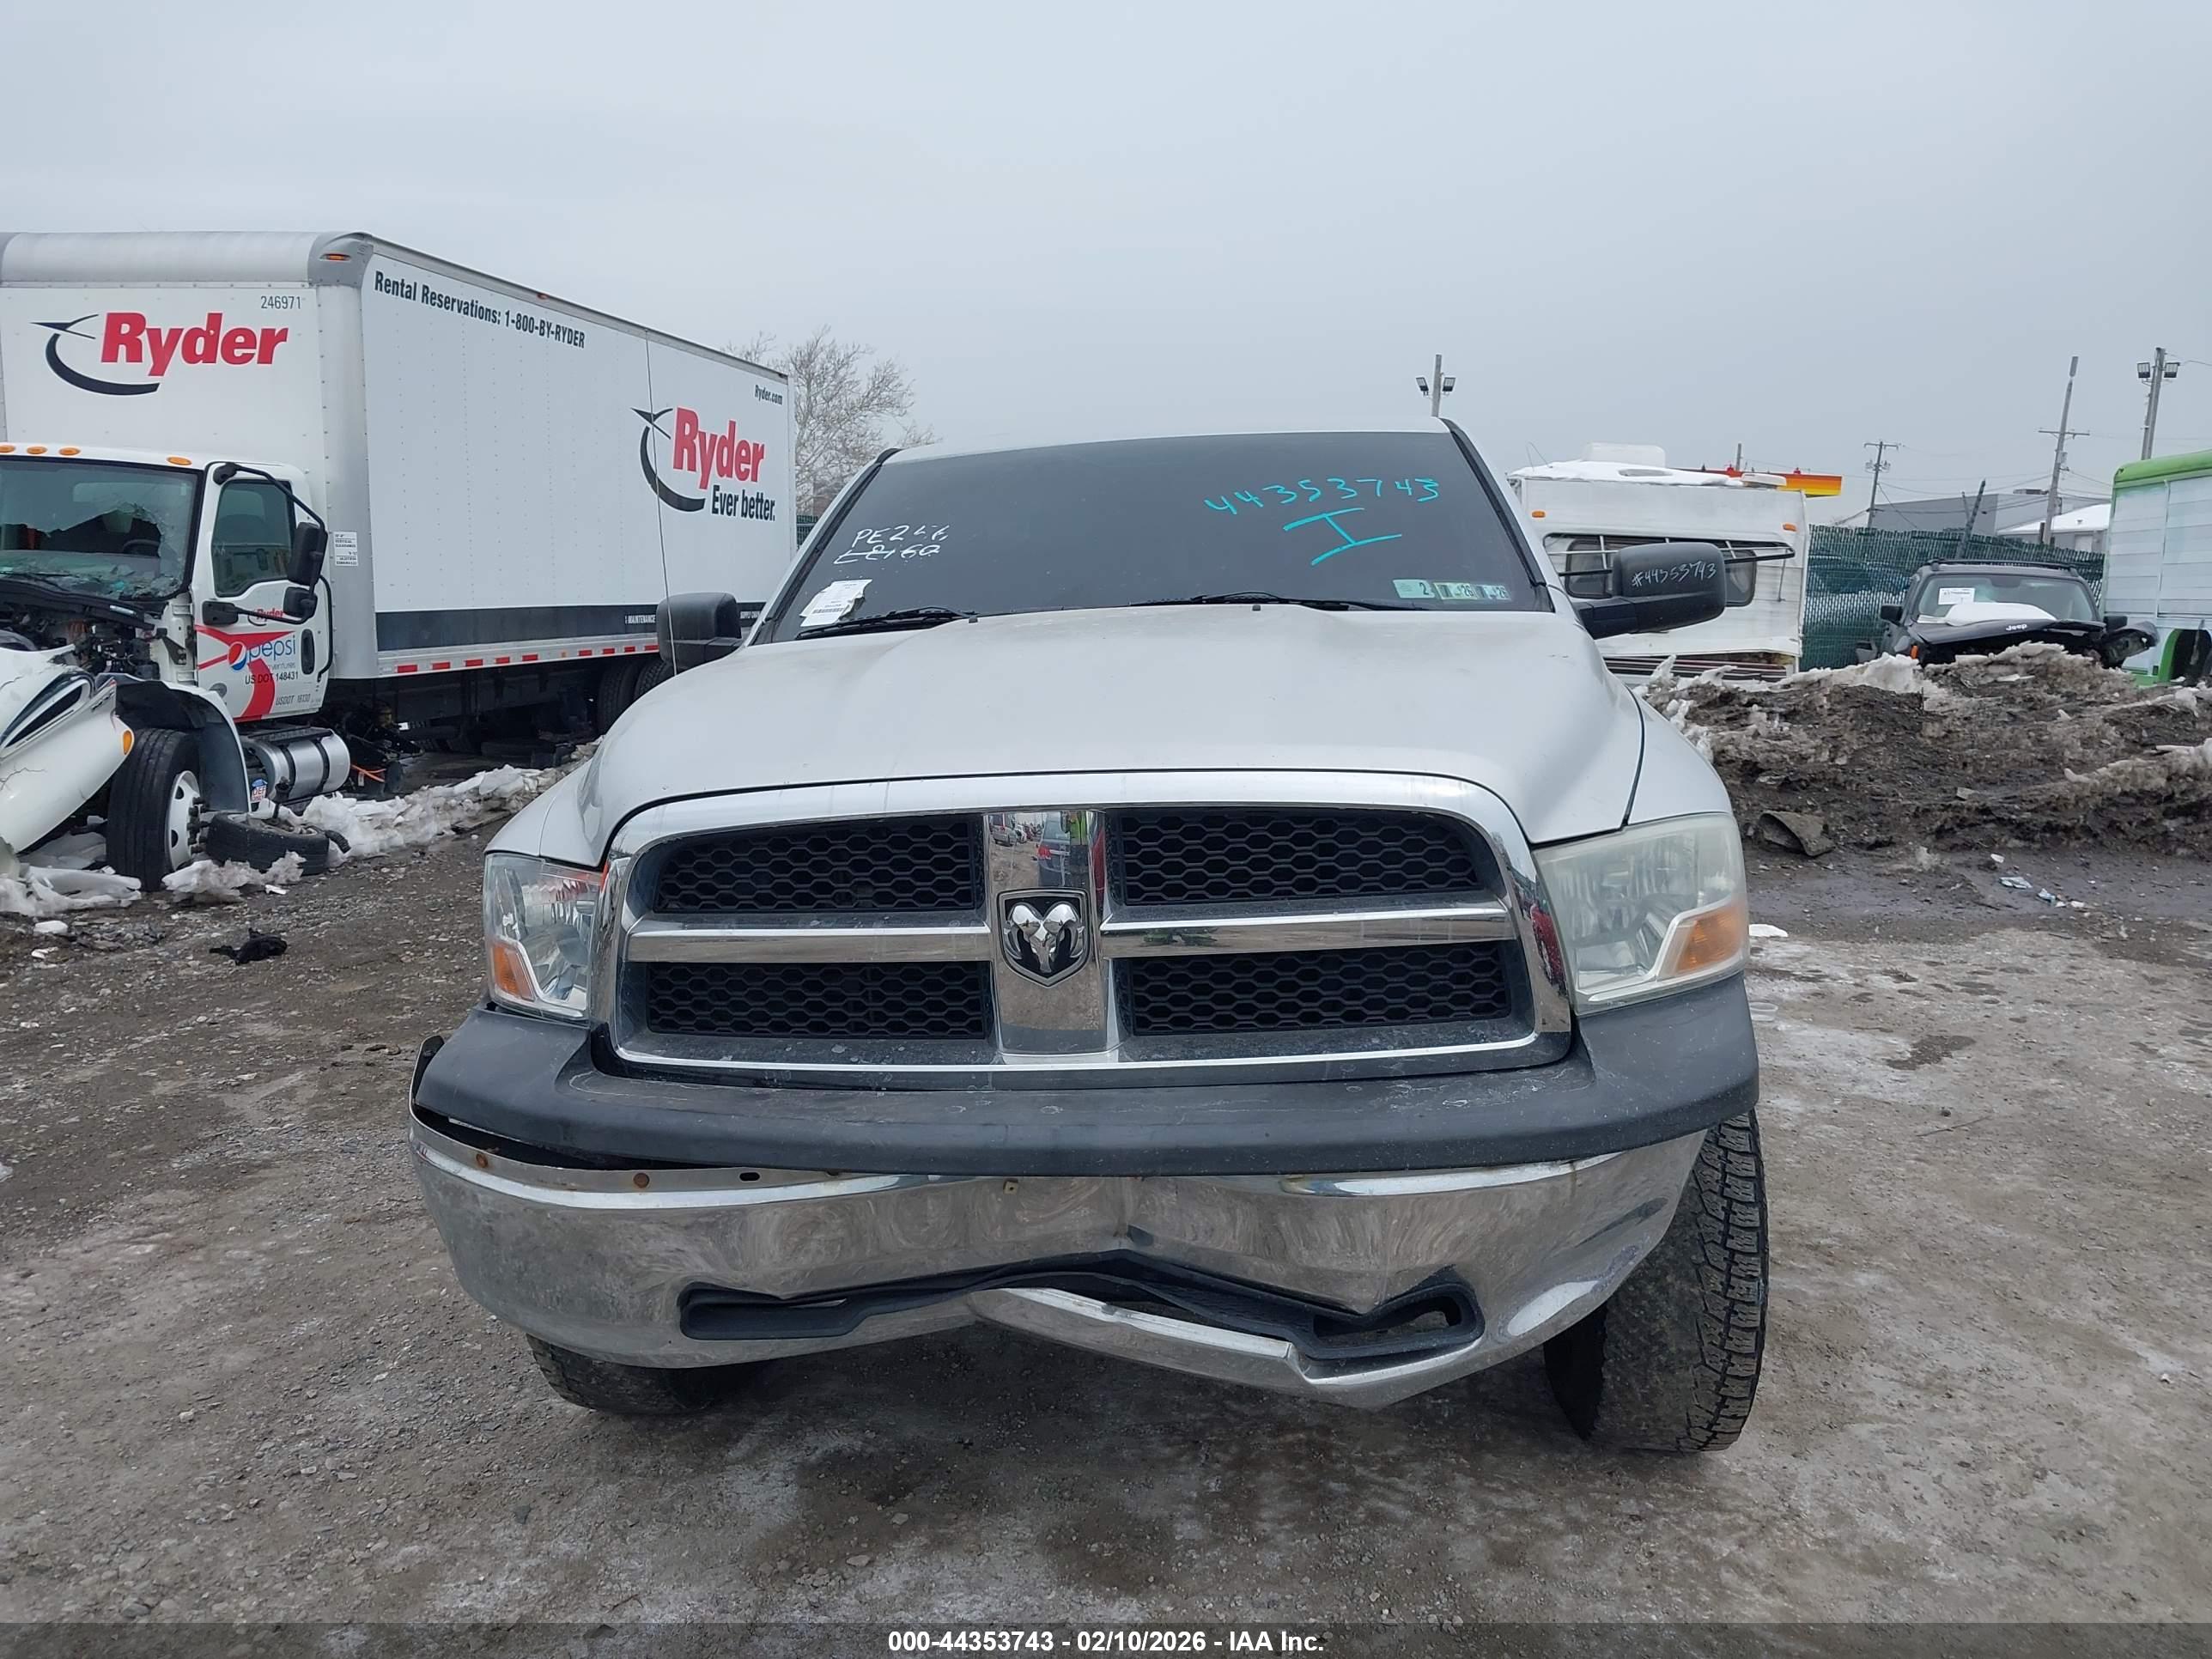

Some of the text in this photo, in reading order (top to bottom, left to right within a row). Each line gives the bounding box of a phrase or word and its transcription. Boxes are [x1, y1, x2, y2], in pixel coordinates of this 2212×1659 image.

[260, 295, 301, 310] 246971
[374, 270, 585, 349] Rental Reservations: 1-800-BY-RYDER
[100, 312, 289, 377] Ryder
[754, 384, 783, 405] Ryder.com
[672, 406, 765, 490] Ryder
[711, 484, 775, 522] Ever better.
[1204, 477, 1439, 515] 44353743
[248, 635, 296, 661] pepsi
[276, 671, 299, 681] 148431
